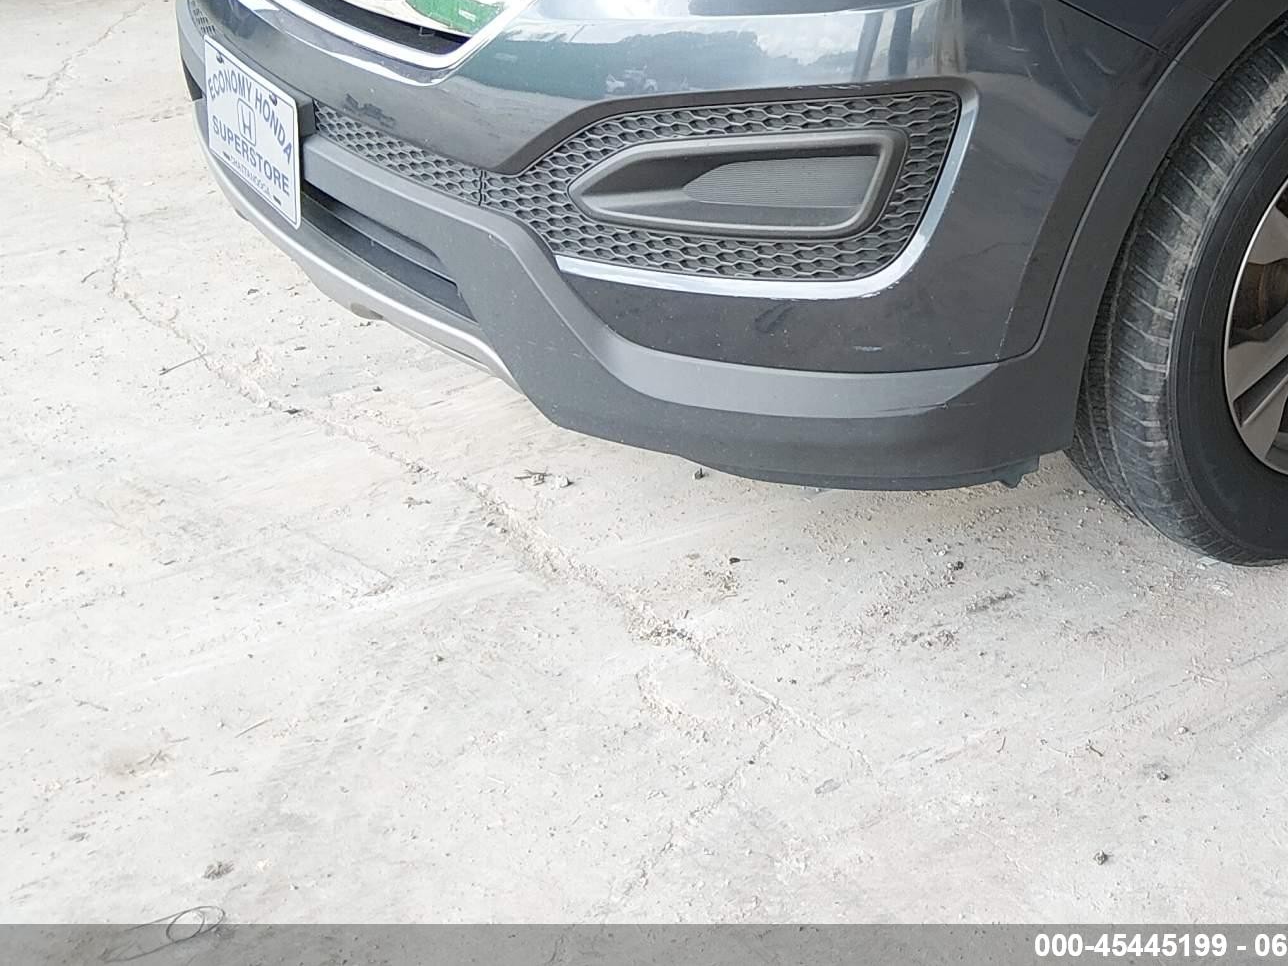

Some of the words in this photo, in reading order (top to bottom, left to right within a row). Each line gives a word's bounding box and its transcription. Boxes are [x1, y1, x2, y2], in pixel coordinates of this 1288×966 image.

[208, 69, 252, 102] ECONOMY
[255, 88, 292, 165] HONDA
[212, 115, 290, 196] SUPERSTORE
